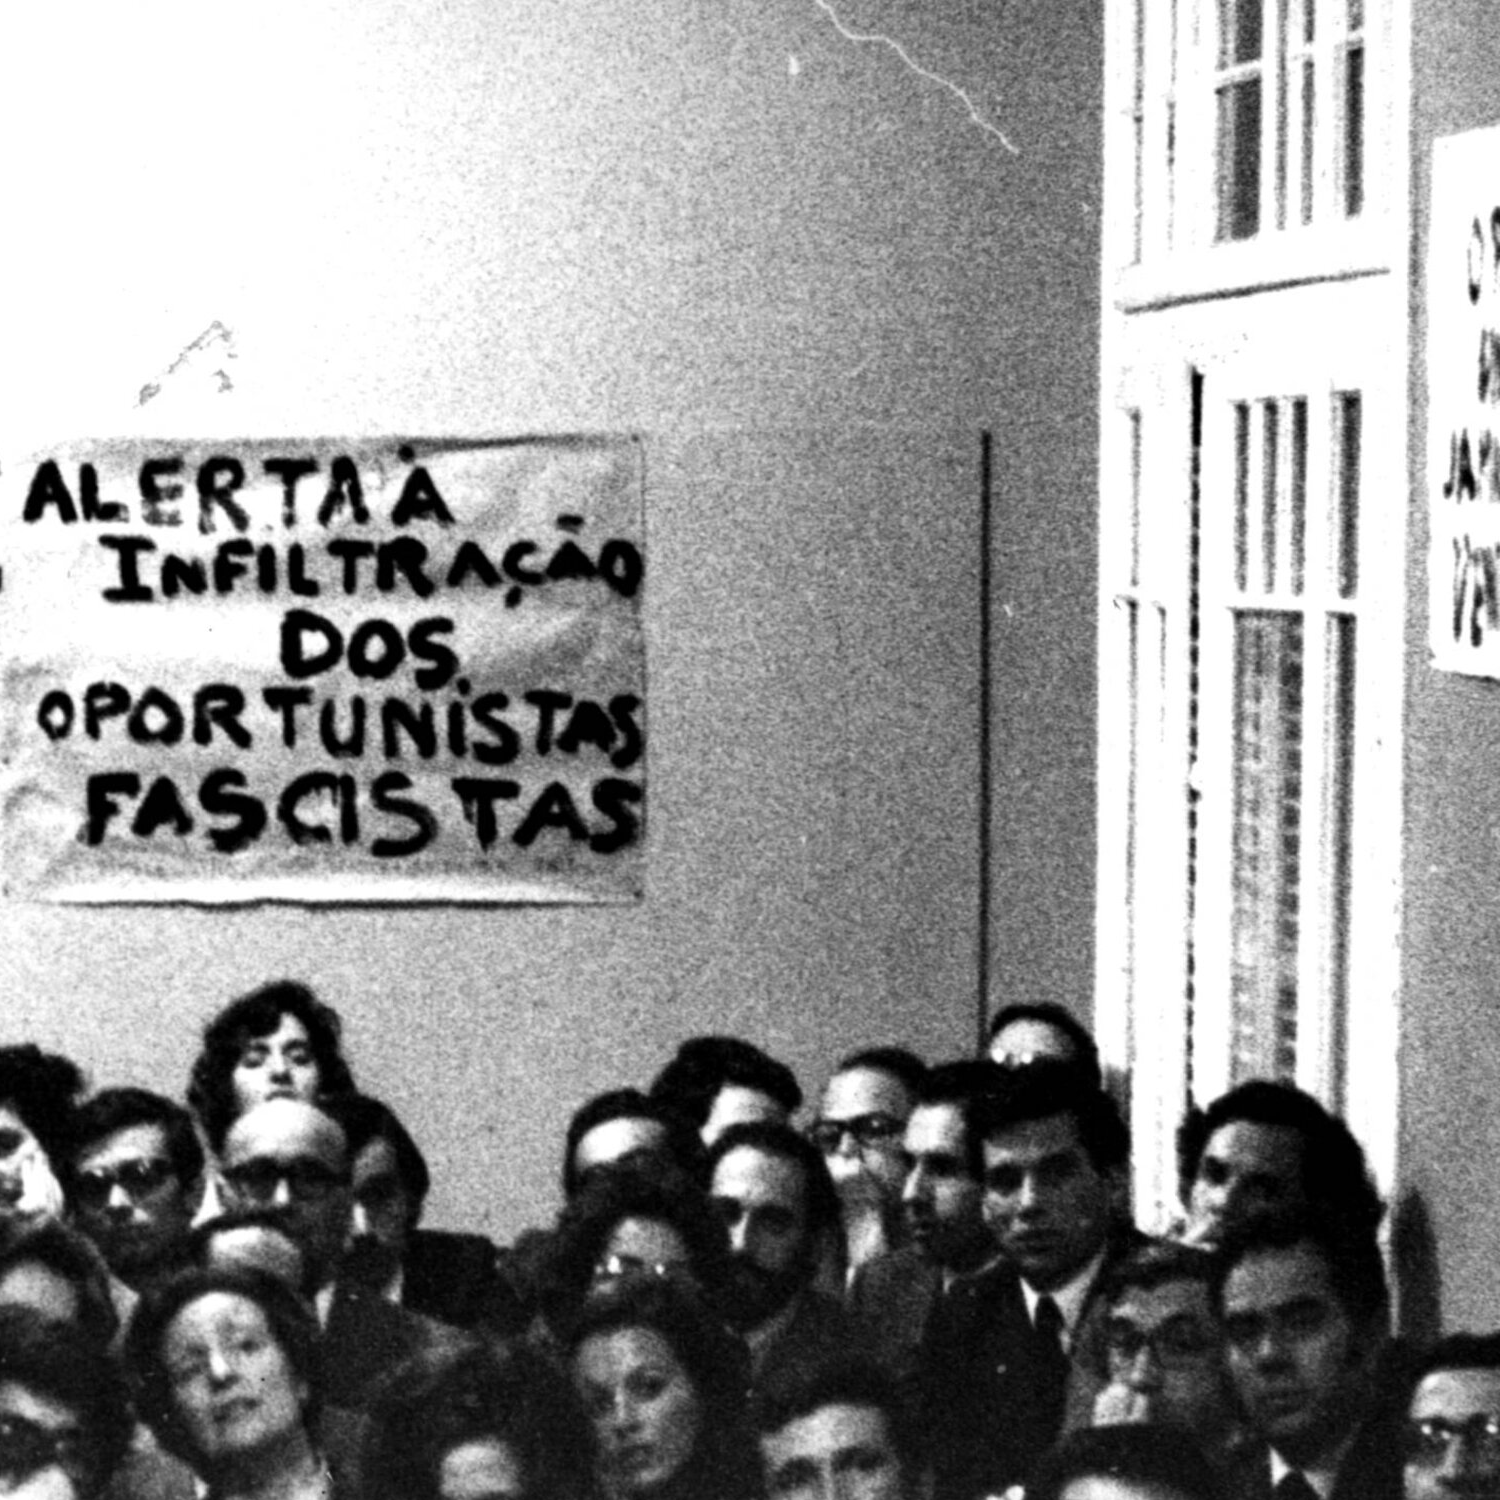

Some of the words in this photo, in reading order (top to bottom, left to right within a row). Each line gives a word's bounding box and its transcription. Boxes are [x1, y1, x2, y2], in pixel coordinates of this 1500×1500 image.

[22, 456, 369, 533] ALERTA
[100, 514, 644, 608] INFILTRAÇÃO
[280, 608, 460, 692] DOS
[37, 676, 643, 770] OPORTUNISTAS
[83, 768, 643, 857] FASCISTAS
